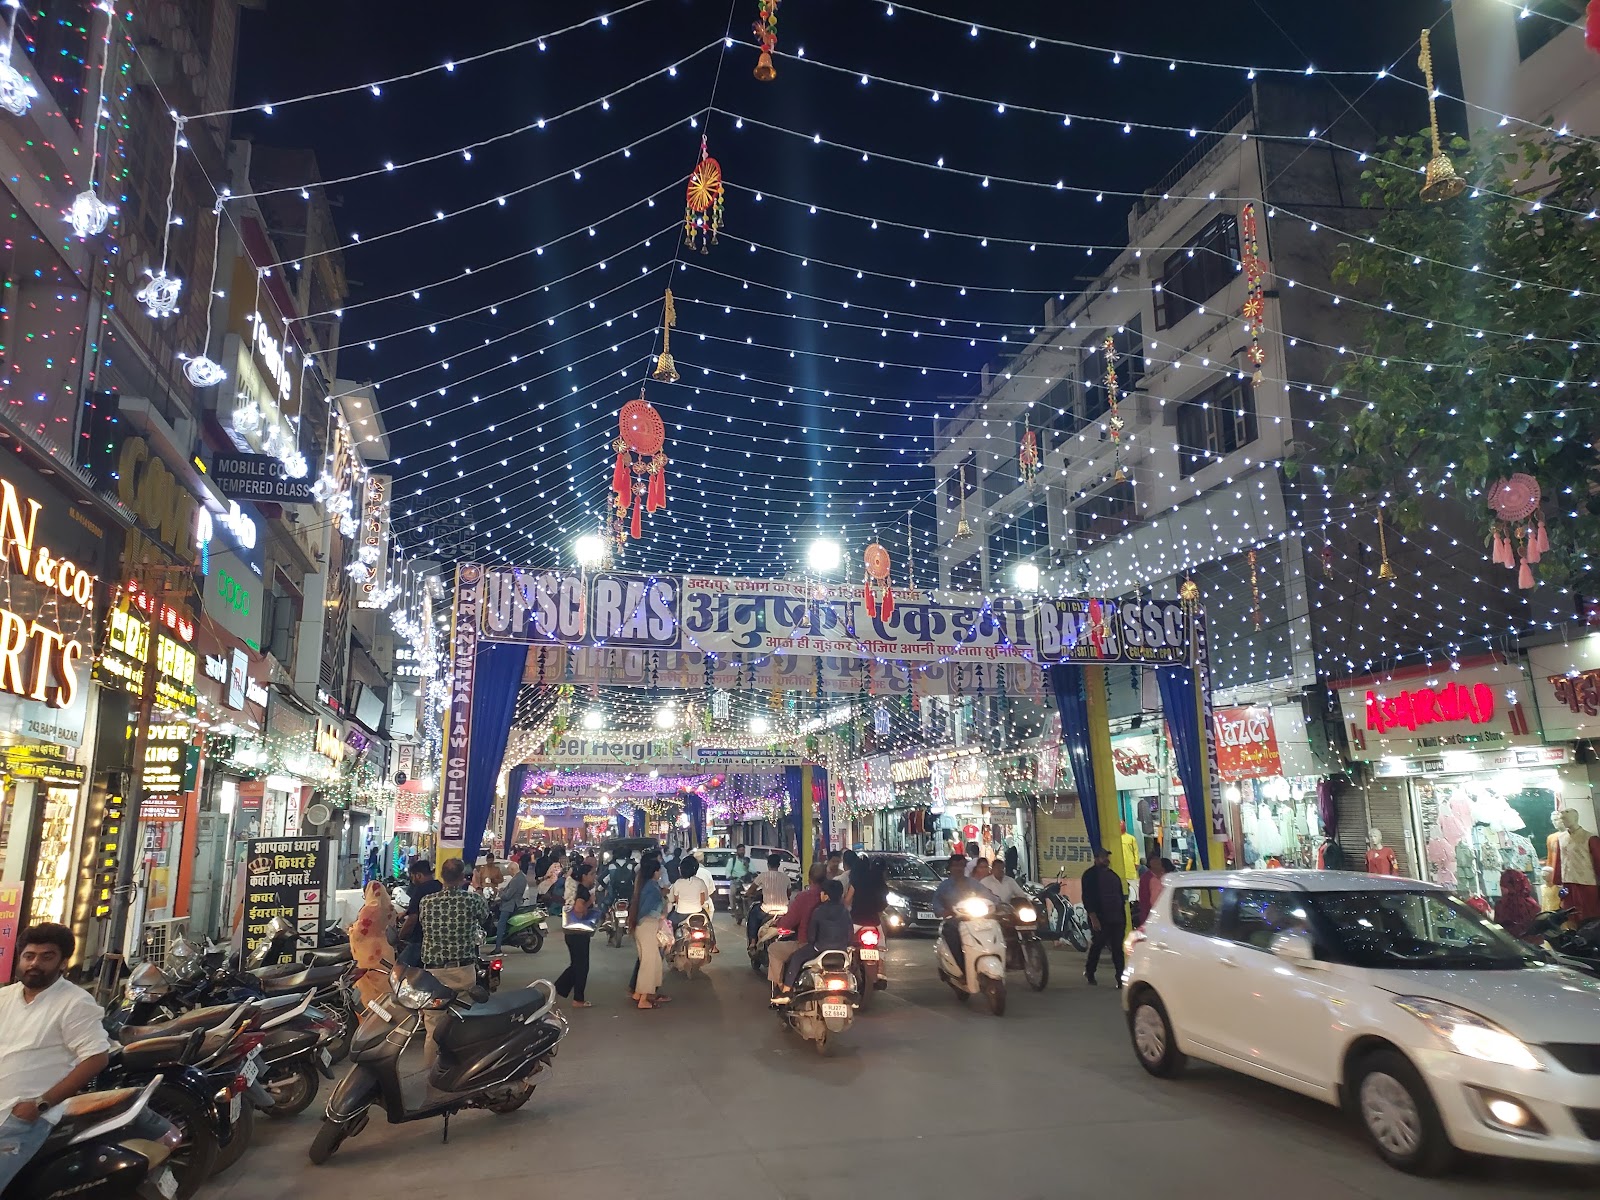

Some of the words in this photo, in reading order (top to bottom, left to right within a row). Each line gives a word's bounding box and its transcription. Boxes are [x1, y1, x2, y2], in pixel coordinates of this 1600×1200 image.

[218, 459, 265, 476] MOBILE
[217, 477, 273, 495] TEMPERED
[276, 482, 310, 498] GLASS
[688, 578, 730, 593] उदयपुर
[488, 567, 580, 636] UPSC
[595, 579, 672, 639] RAS
[686, 592, 861, 649] अनुष्का
[1123, 603, 1183, 647] SSC
[766, 636, 793, 650] आज
[797, 635, 809, 649] ही
[901, 641, 935, 655] अपनी
[453, 622, 475, 704] ANUSHKA
[58, 727, 78, 743] BAZAR
[135, 724, 189, 740] OVER
[450, 711, 468, 748] LAW
[1485, 730, 1504, 743] Store
[717, 757, 733, 765] CMA
[1205, 728, 1225, 830] ACADEMY
[443, 757, 466, 838] COLLEGE
[829, 783, 837, 834] Heights
[254, 840, 293, 854] आपका
[294, 840, 320, 852] ध्यान
[274, 854, 306, 870] किधर
[250, 874, 268, 887] कवर
[269, 870, 287, 886] किंग
[287, 872, 303, 887] इधर
[250, 893, 275, 903] कवर
